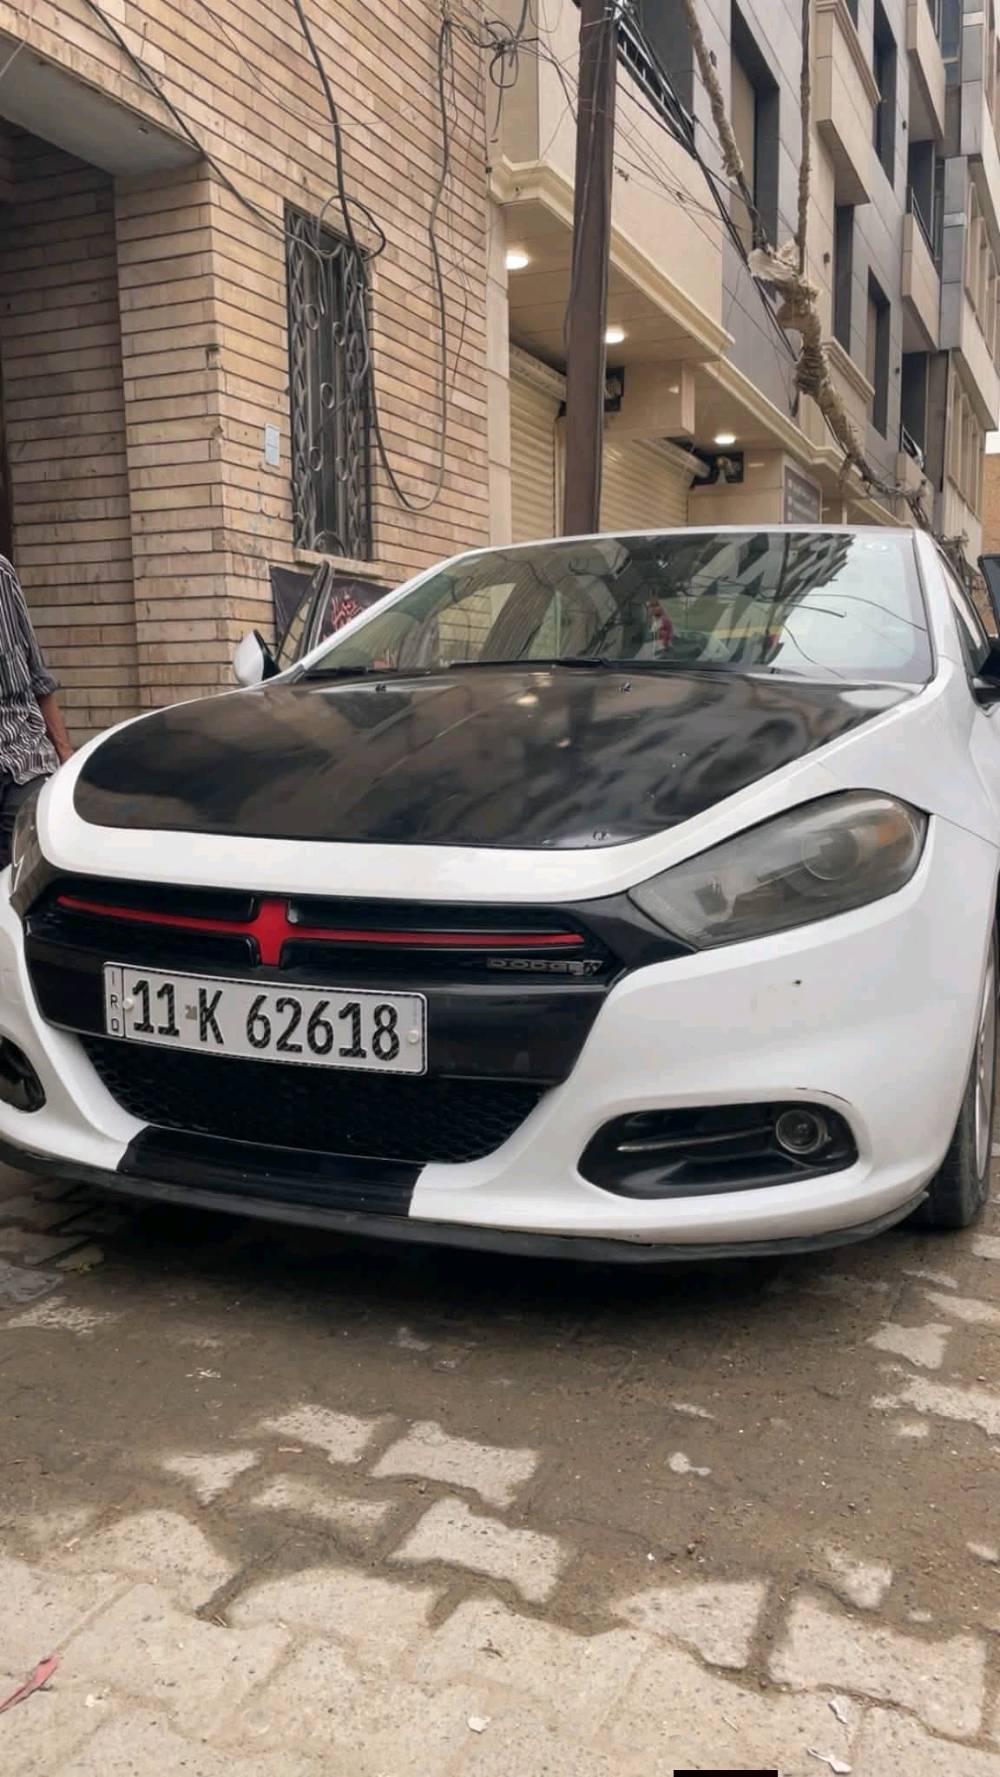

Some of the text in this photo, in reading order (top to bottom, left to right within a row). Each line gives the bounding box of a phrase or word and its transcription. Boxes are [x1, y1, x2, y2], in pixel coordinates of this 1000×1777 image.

[487, 957, 583, 975] DODGE
[132, 980, 400, 1061] 11 K 62618
